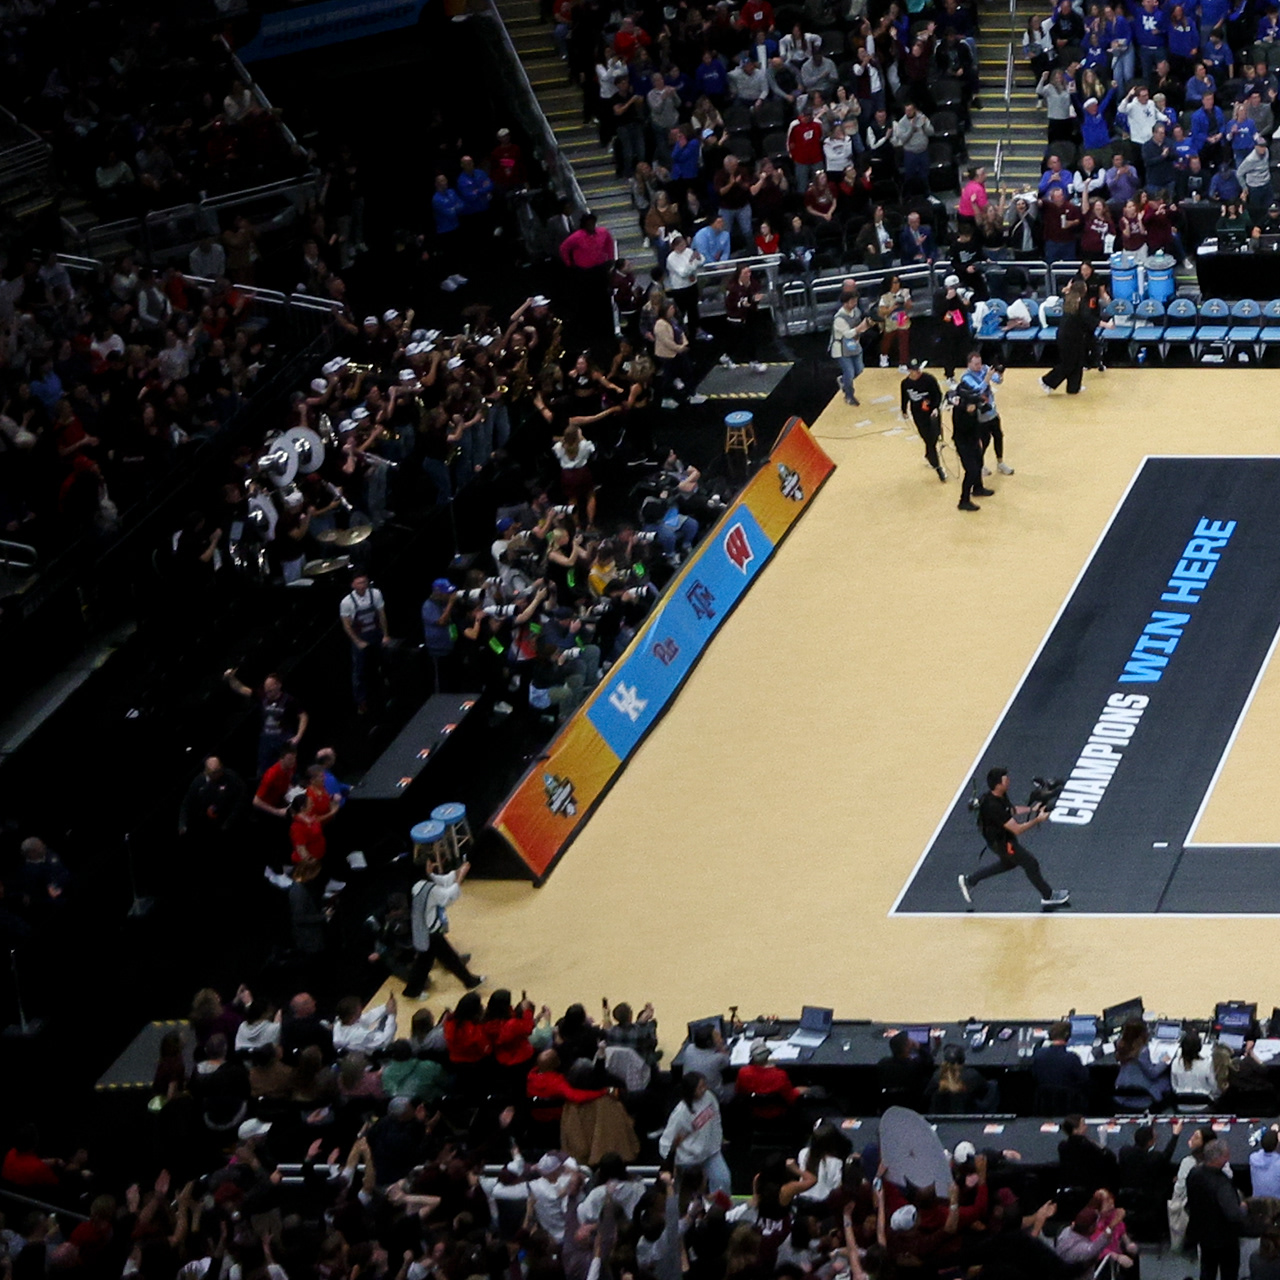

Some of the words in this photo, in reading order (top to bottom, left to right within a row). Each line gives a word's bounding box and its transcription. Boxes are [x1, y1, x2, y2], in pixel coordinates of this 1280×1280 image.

[1049, 692, 1150, 825] CHAMPIONS
[1118, 611, 1191, 683] WIN
[1160, 516, 1238, 603] HERE
